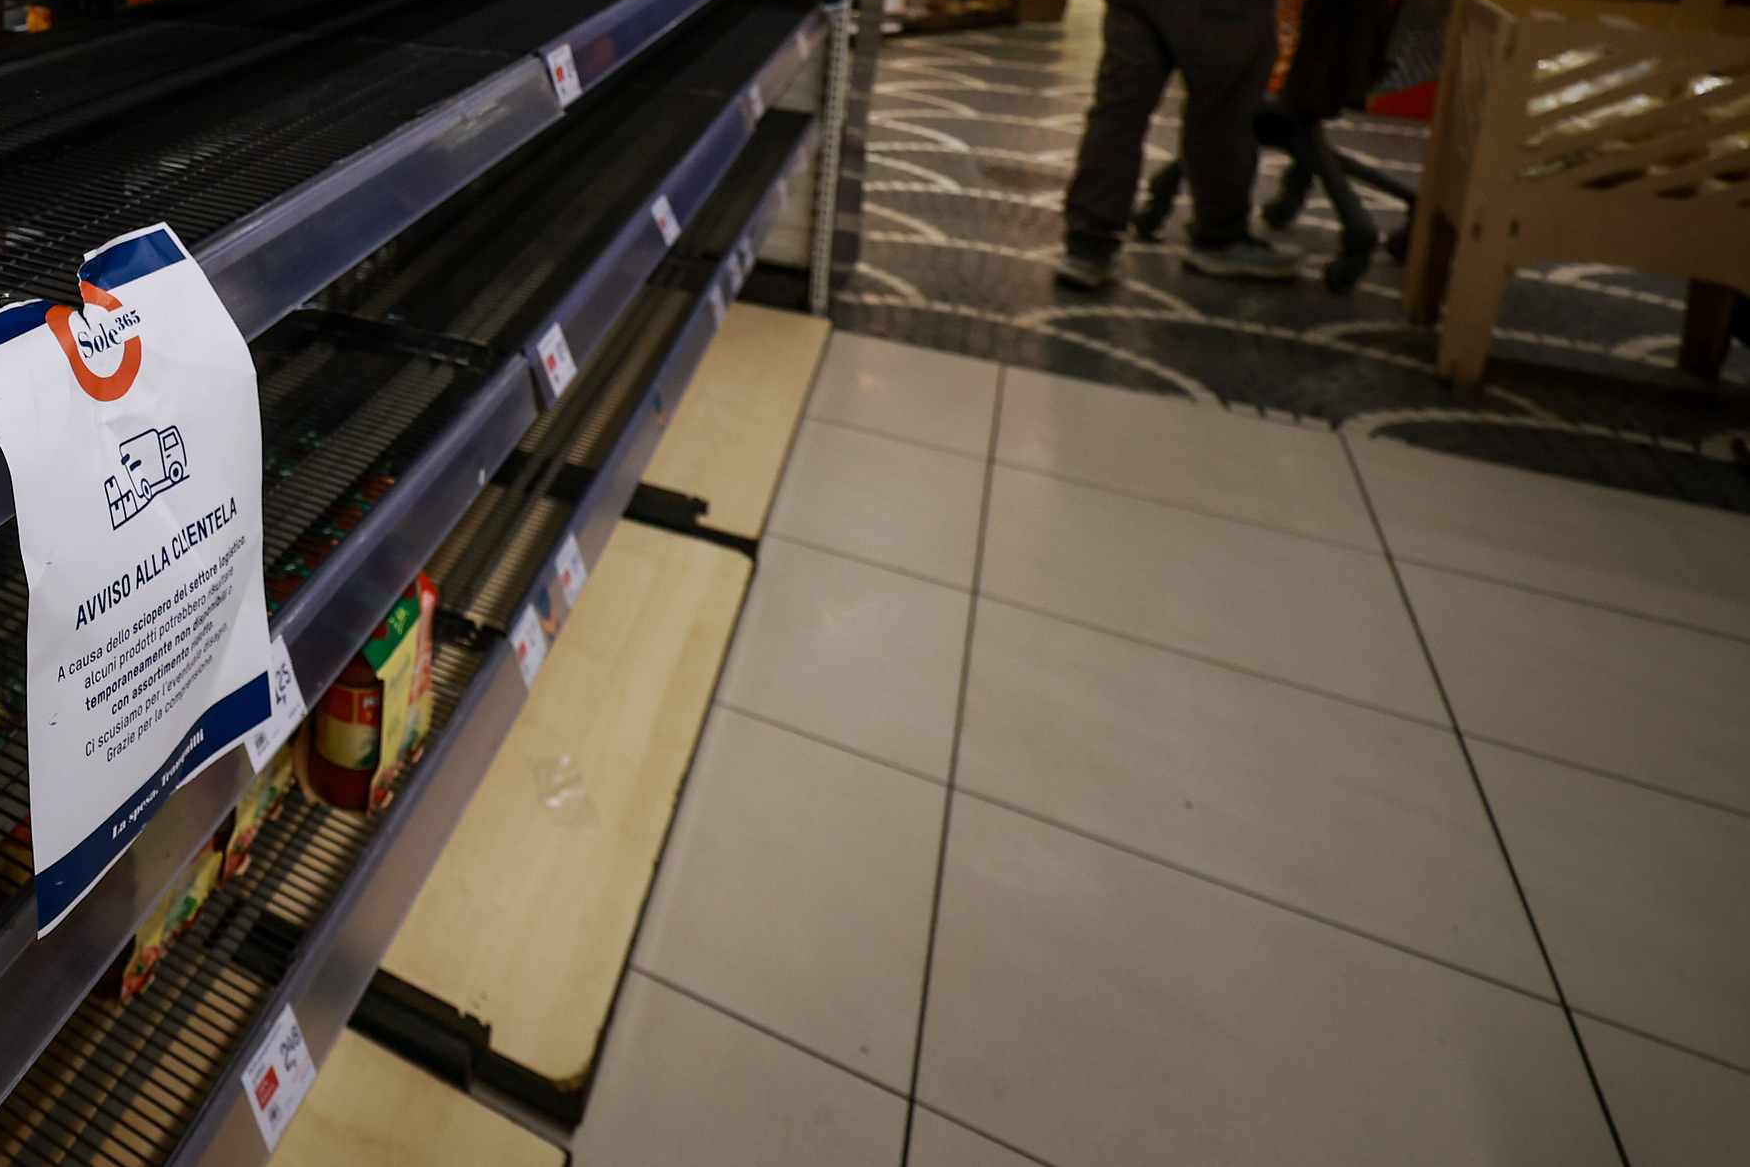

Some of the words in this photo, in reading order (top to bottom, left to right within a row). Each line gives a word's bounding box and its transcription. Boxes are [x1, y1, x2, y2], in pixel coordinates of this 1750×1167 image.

[75, 573, 131, 631] AVVISO
[136, 546, 171, 590] ALLA
[171, 496, 238, 560] CLIENTELA
[57, 665, 66, 683] A
[69, 647, 103, 675] causa
[106, 628, 131, 653] dello
[132, 597, 172, 635] sciopero
[174, 583, 188, 604] del
[189, 564, 218, 593] settore
[84, 655, 117, 689] alcuni
[119, 627, 157, 669] prodotti
[159, 595, 207, 641] potrebbero
[84, 641, 173, 711] temporaneamente
[175, 627, 191, 647] non
[111, 694, 130, 715] con
[131, 647, 190, 700] assortimento
[85, 738, 95, 757] Ci
[97, 705, 143, 748] scusiamo
[145, 690, 161, 713] per
[106, 732, 135, 763] Grazie
[137, 717, 153, 740] per
[154, 708, 163, 722] la
